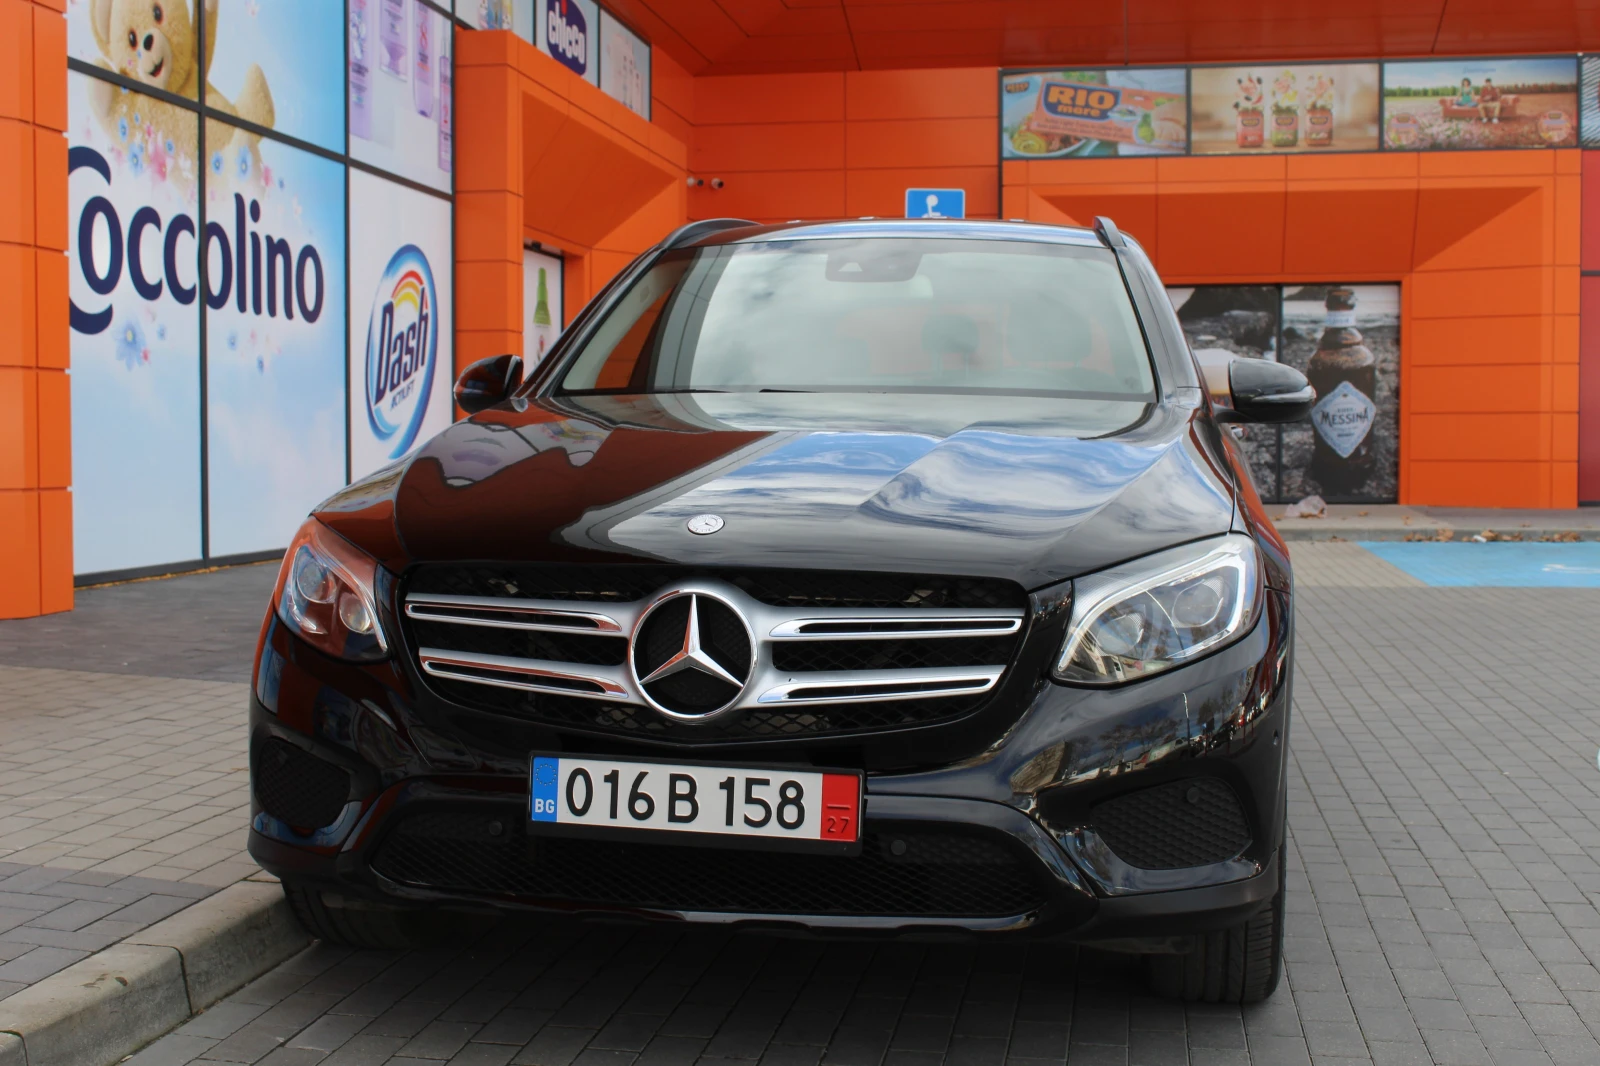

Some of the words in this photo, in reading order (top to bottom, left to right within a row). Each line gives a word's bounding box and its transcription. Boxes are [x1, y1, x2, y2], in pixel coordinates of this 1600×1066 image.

[549, 0, 586, 64] chicco
[1047, 85, 1115, 110] RIO
[1057, 105, 1101, 118] mare
[374, 286, 429, 406] Dash
[1320, 406, 1369, 428] MESSINA
[534, 798, 555, 814] BG
[719, 776, 806, 830] 158
[827, 816, 850, 834] 27
